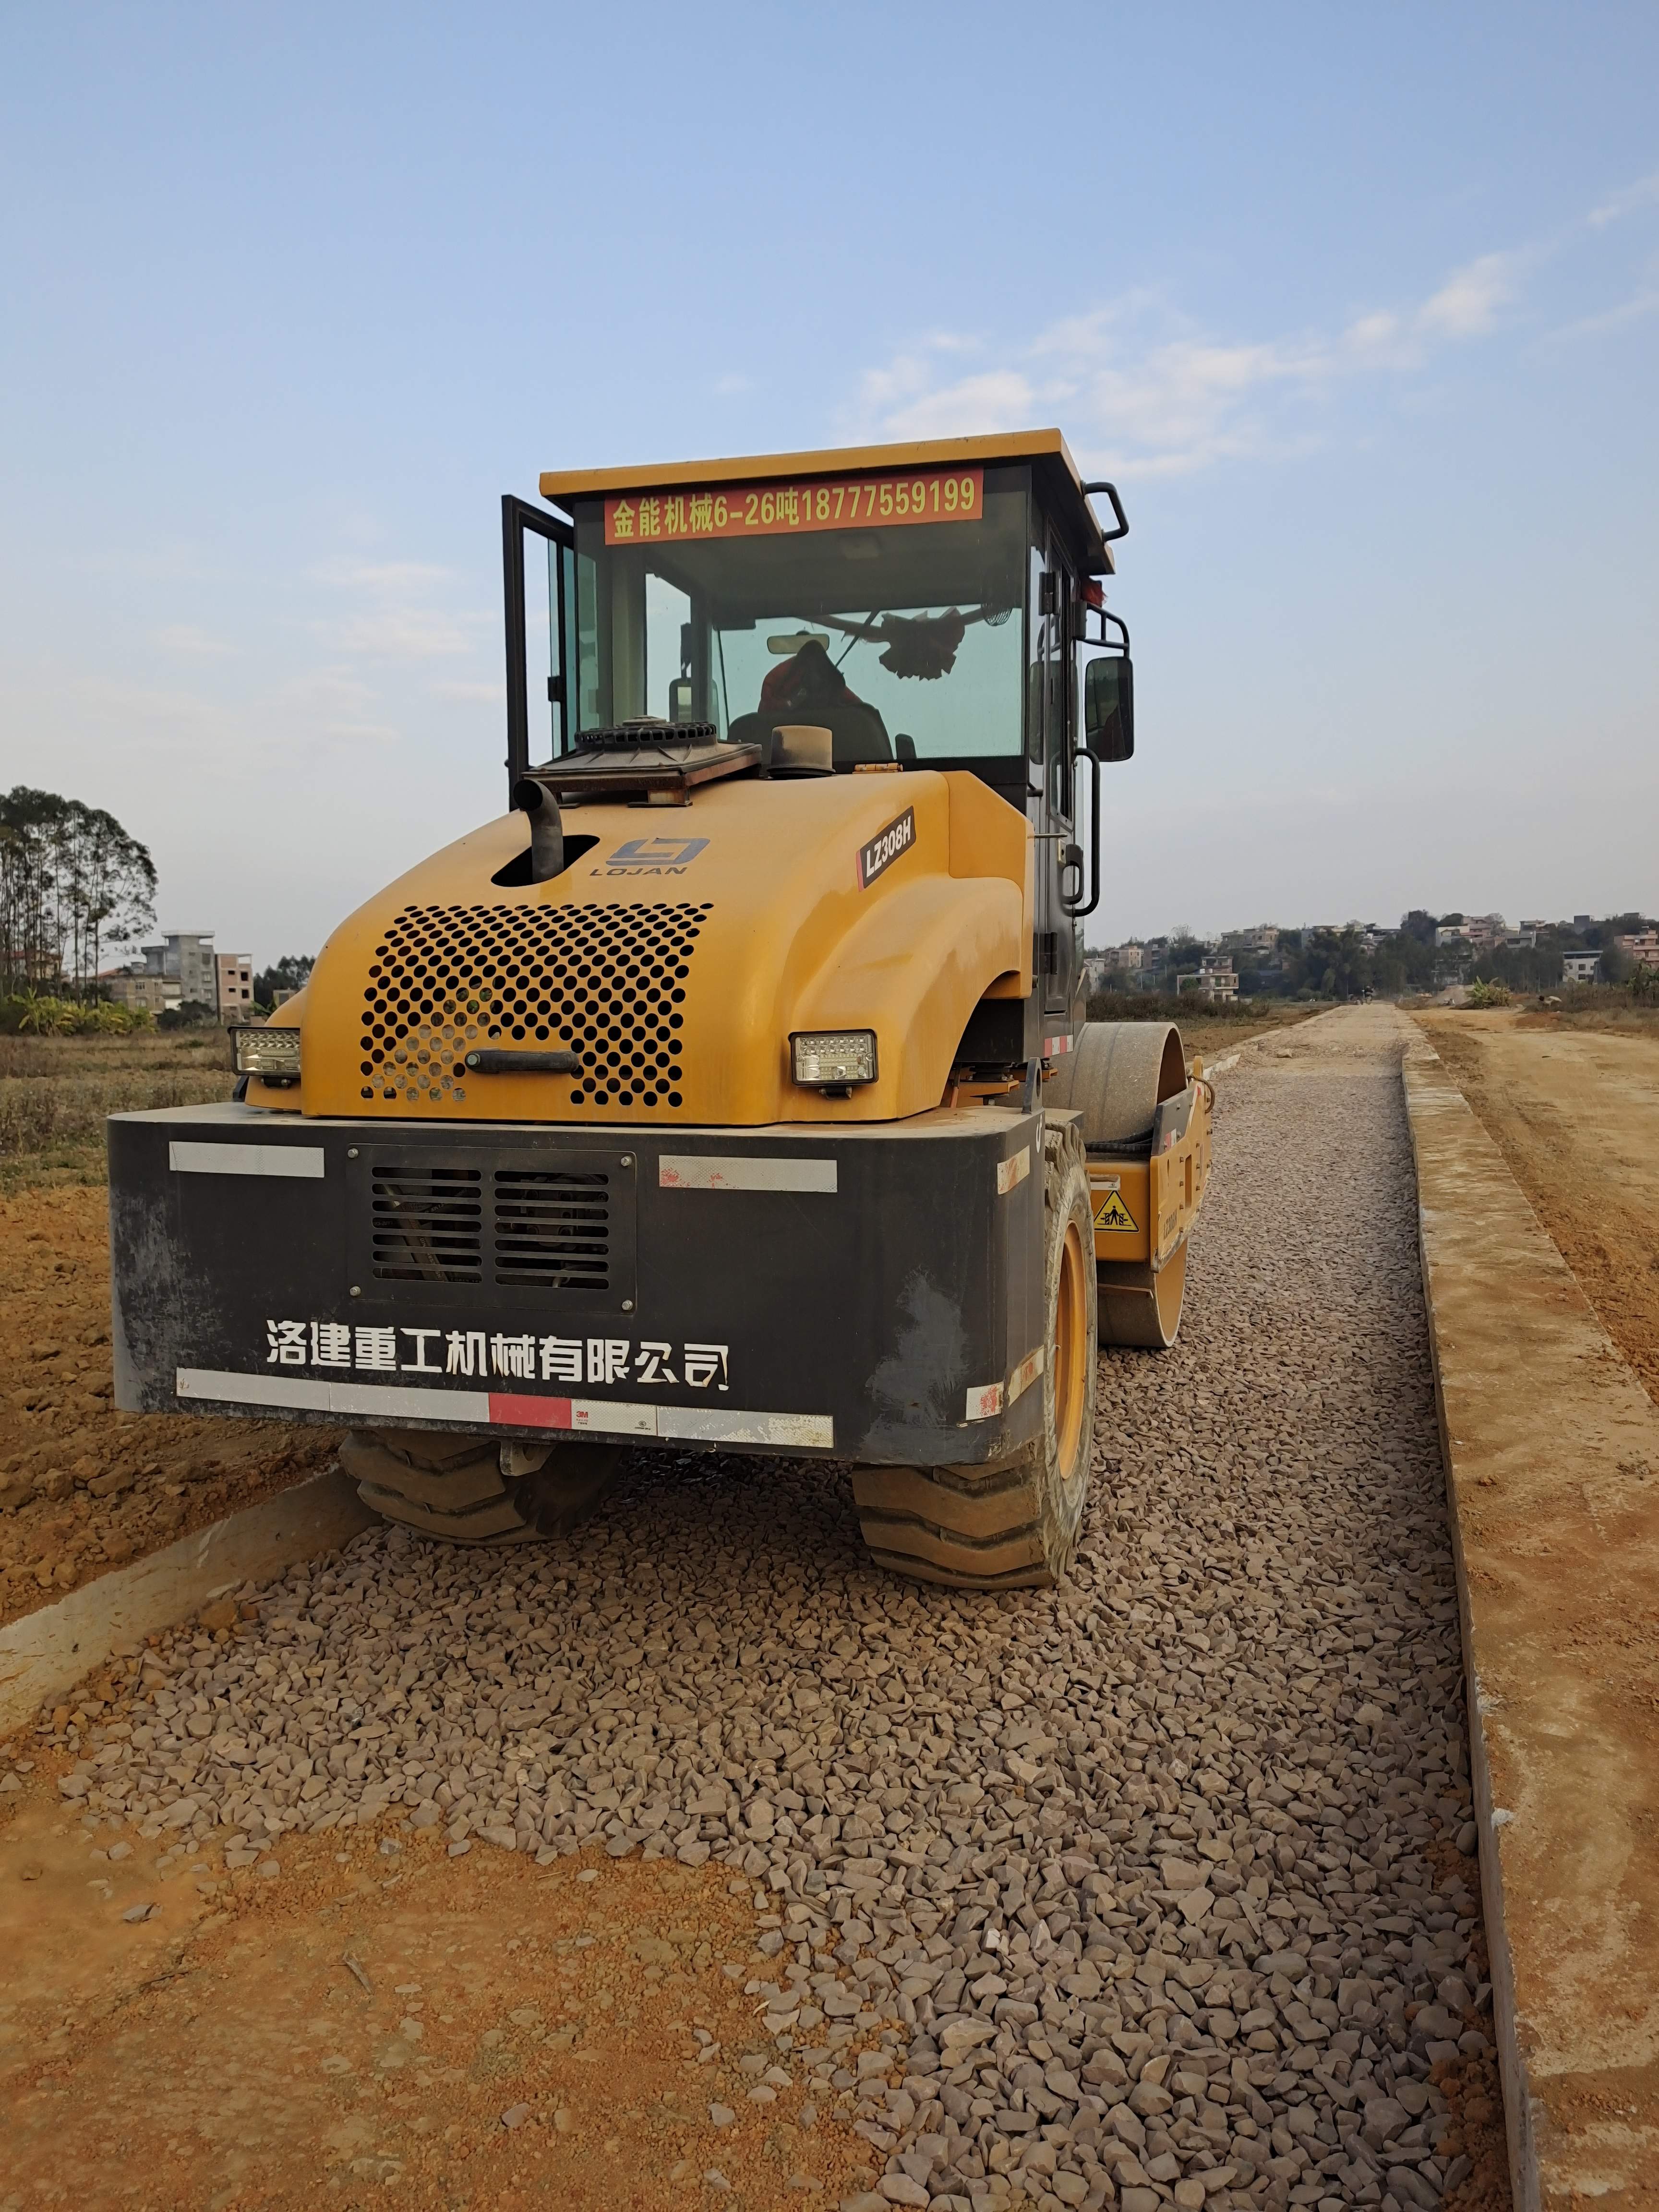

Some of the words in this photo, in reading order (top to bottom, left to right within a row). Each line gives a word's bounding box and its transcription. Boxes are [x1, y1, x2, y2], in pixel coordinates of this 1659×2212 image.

[613, 478, 975, 538] 金能机械6-26吨18777559199
[589, 867, 687, 876] LOJAN
[866, 816, 911, 878] LZ308H
[266, 1320, 729, 1391] 洛建重工机械有限公司
